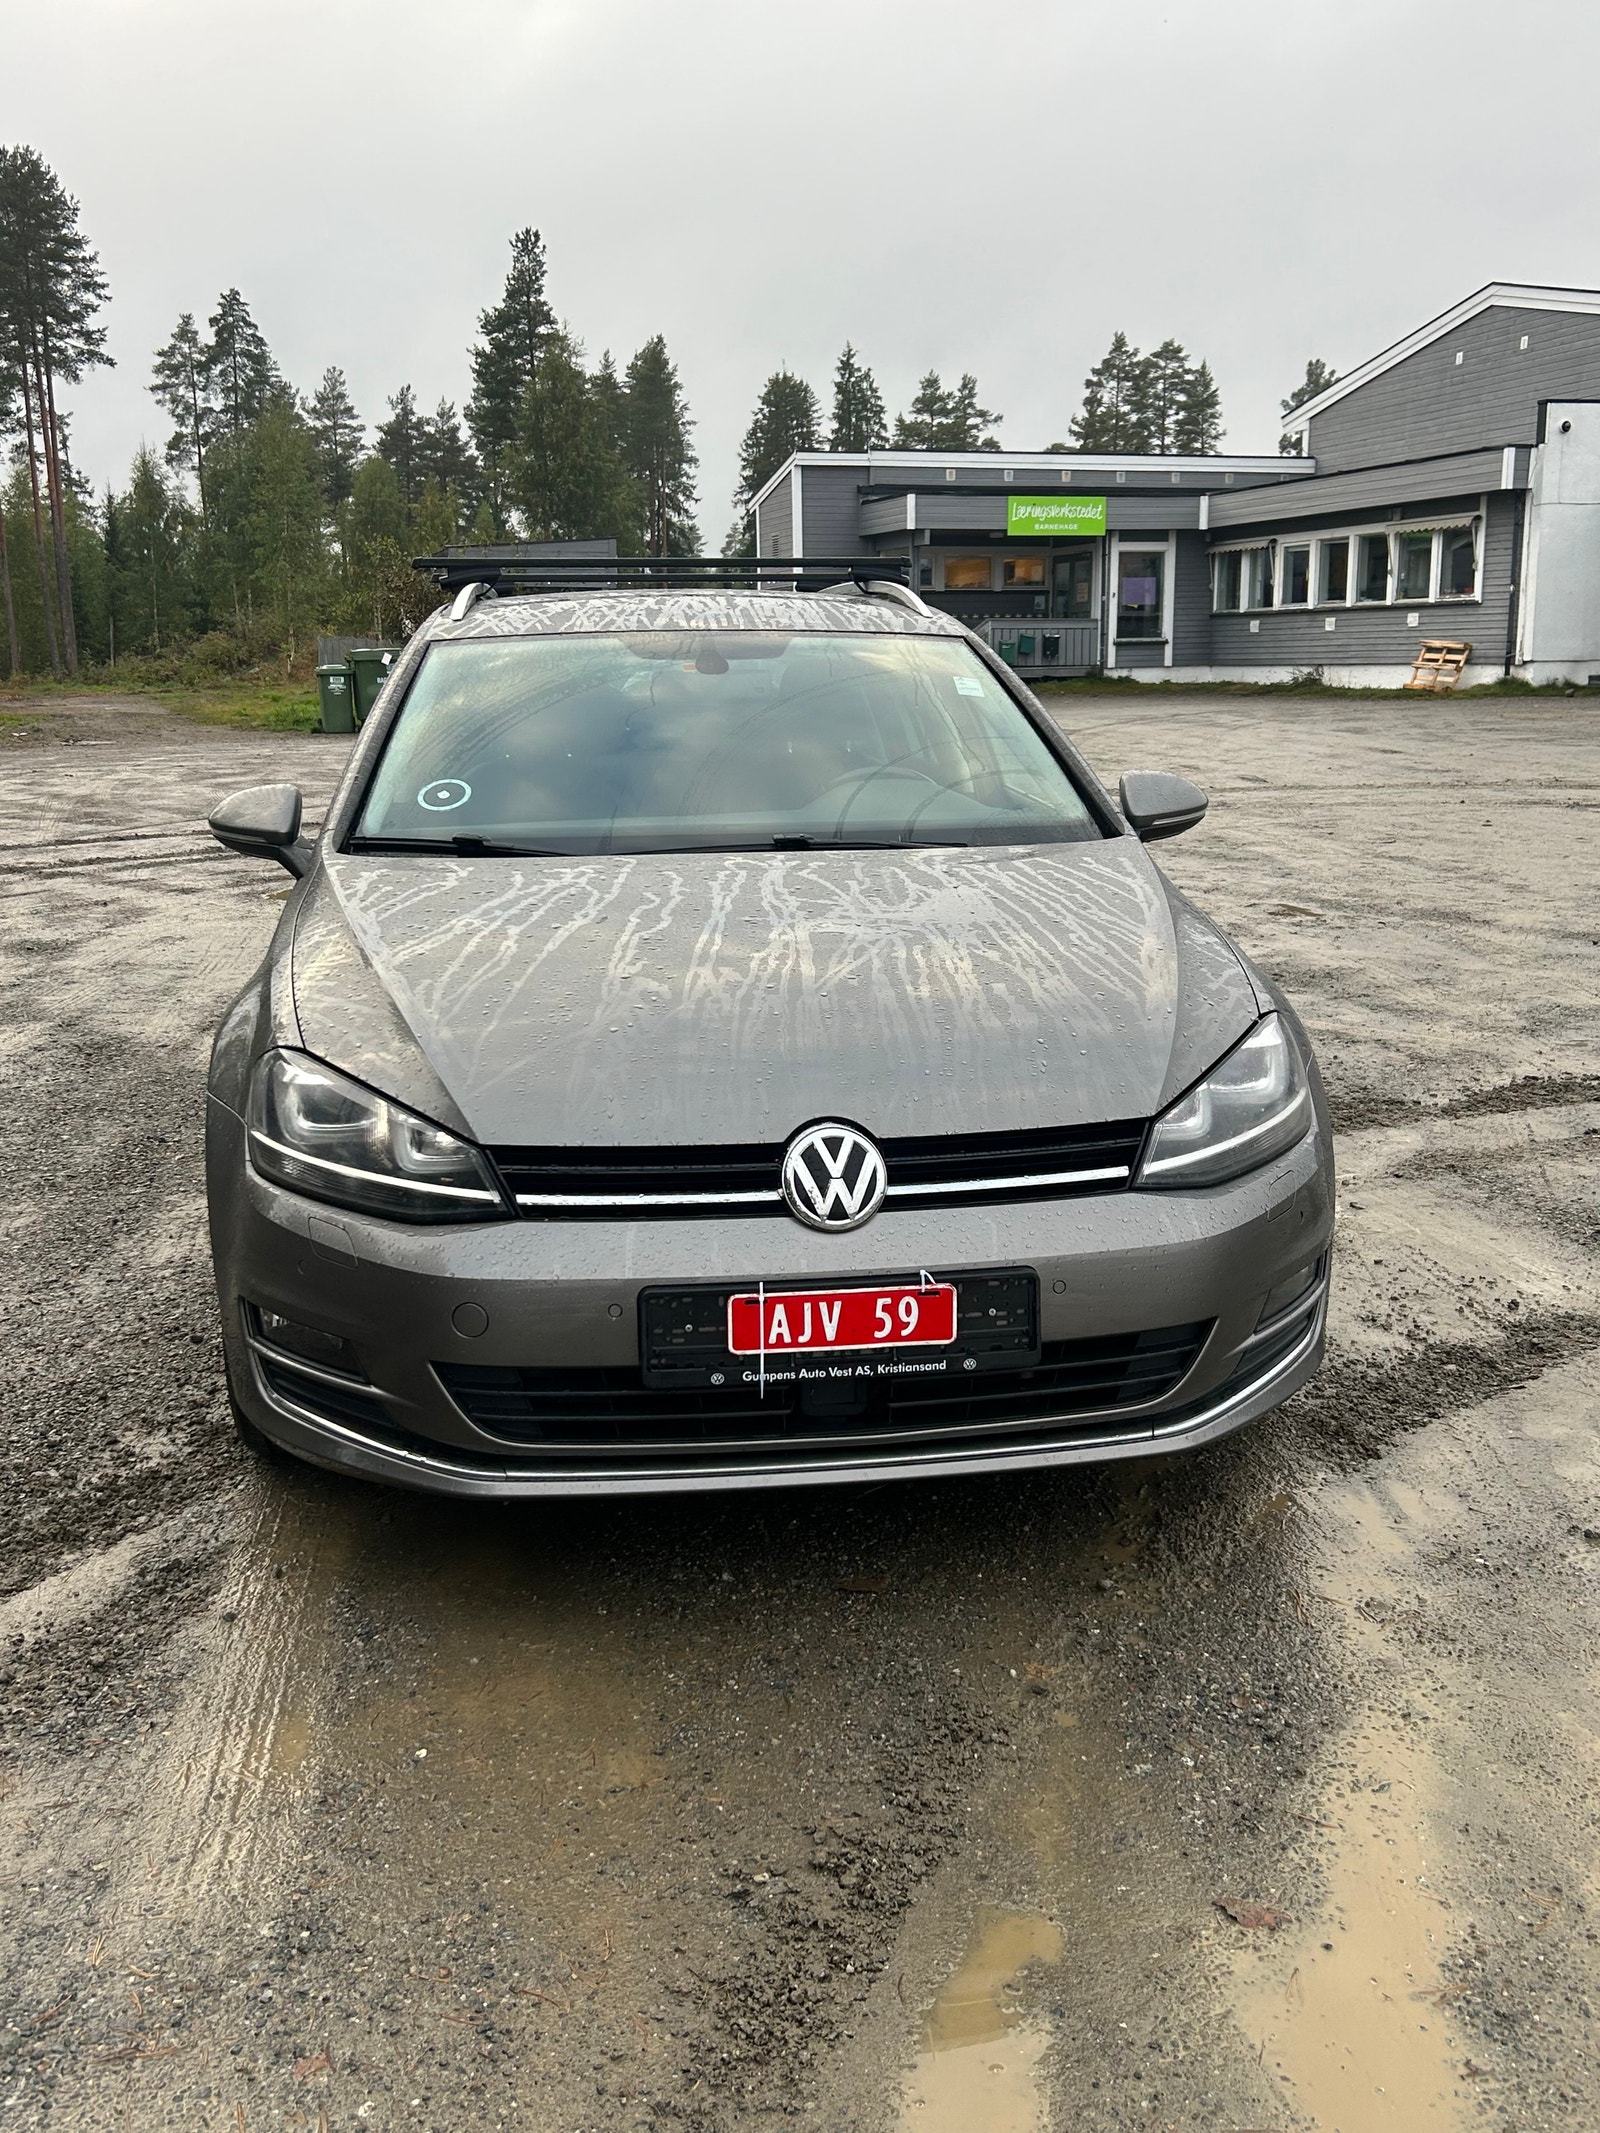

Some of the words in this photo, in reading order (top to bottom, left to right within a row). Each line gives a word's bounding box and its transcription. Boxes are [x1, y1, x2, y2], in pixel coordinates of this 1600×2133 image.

[1034, 523, 1079, 531] BARNEHAGE
[789, 1131, 880, 1223] VW
[768, 1300, 842, 1344] AJV
[873, 1296, 919, 1339] 59
[742, 1370, 796, 1383] Gumpens
[798, 1368, 826, 1379] Auto
[828, 1366, 852, 1378] Vest
[855, 1365, 874, 1377] AS,
[877, 1360, 947, 1375] Kristiansand
